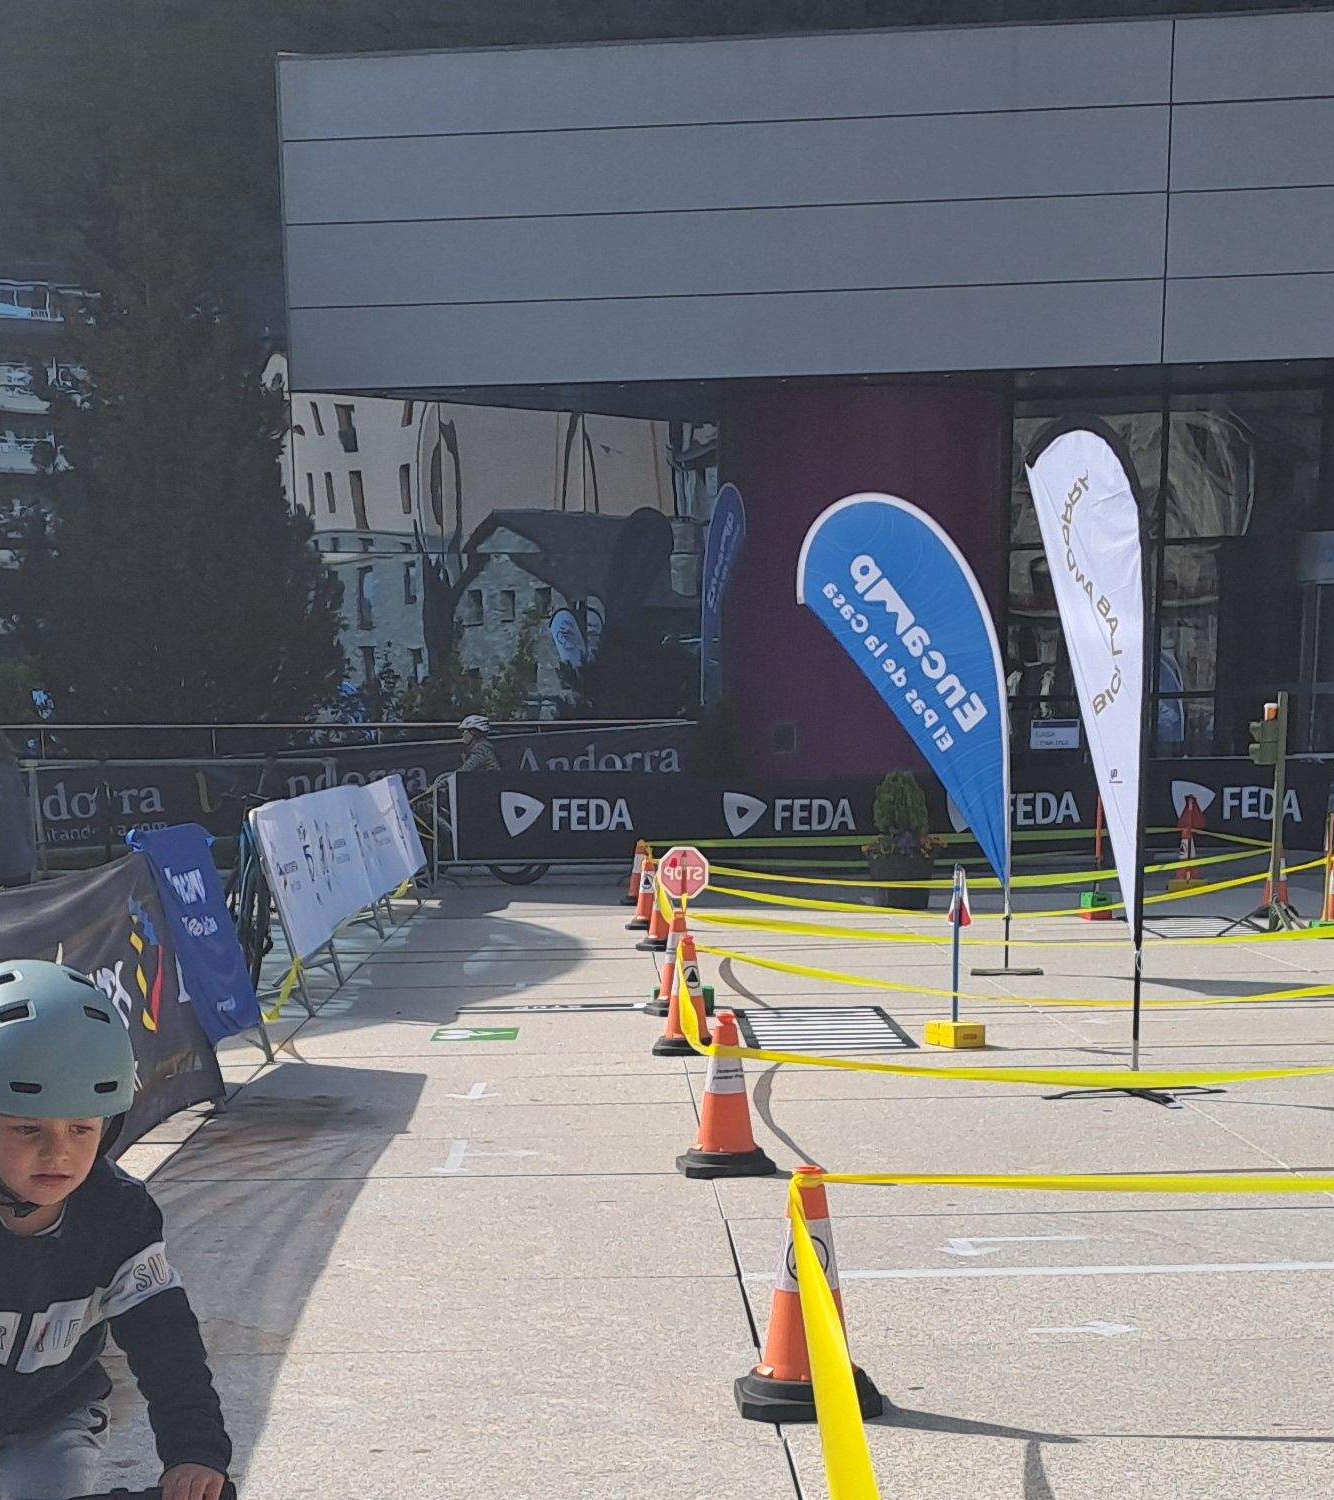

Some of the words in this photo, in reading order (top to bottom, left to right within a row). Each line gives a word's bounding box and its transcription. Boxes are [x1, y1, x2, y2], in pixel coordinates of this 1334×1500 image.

[552, 798, 634, 831] FEDA
[774, 798, 856, 832] FEDA
[1223, 786, 1303, 823] FEDA
